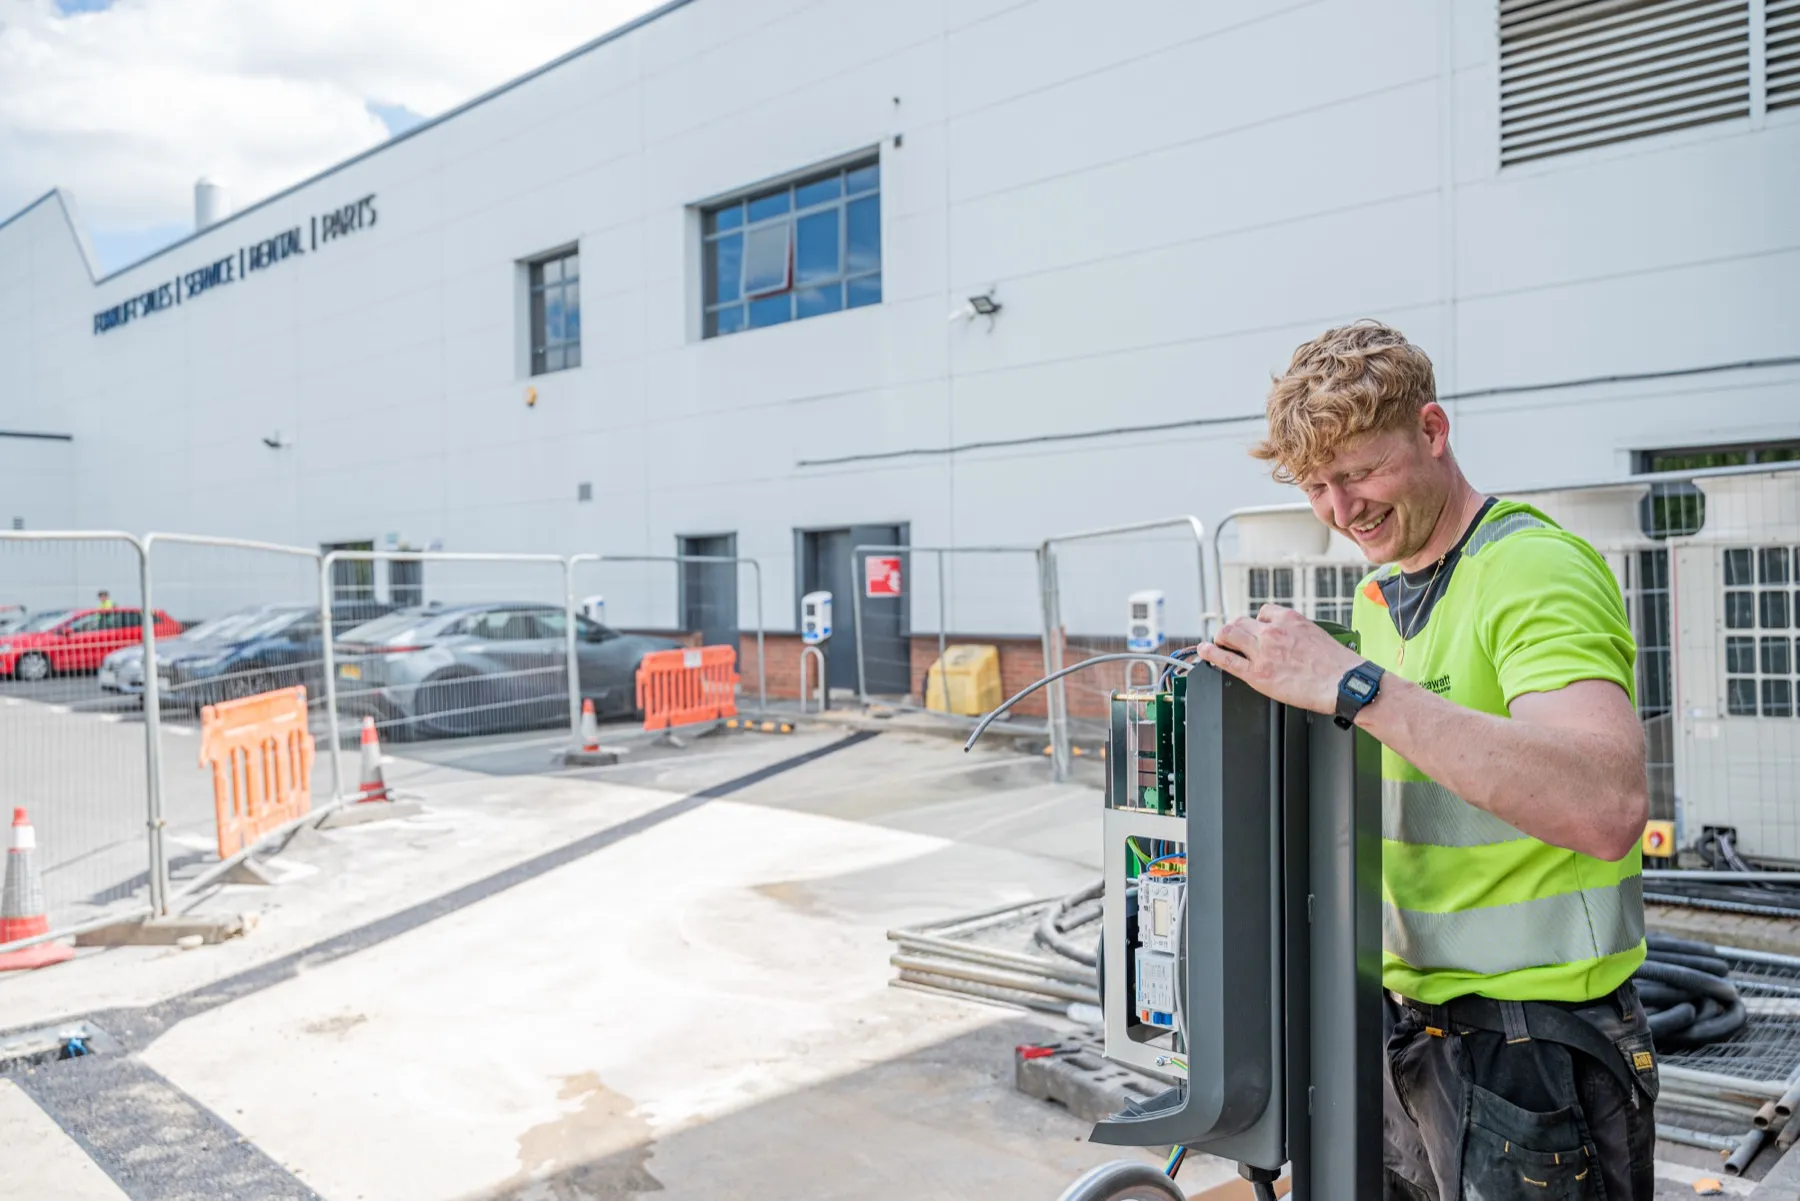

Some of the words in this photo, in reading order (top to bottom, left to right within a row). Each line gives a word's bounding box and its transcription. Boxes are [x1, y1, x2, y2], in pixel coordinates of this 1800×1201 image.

[184, 254, 235, 298] SERVICE
[249, 226, 304, 271] RENTAL
[322, 193, 377, 243] PARTS
